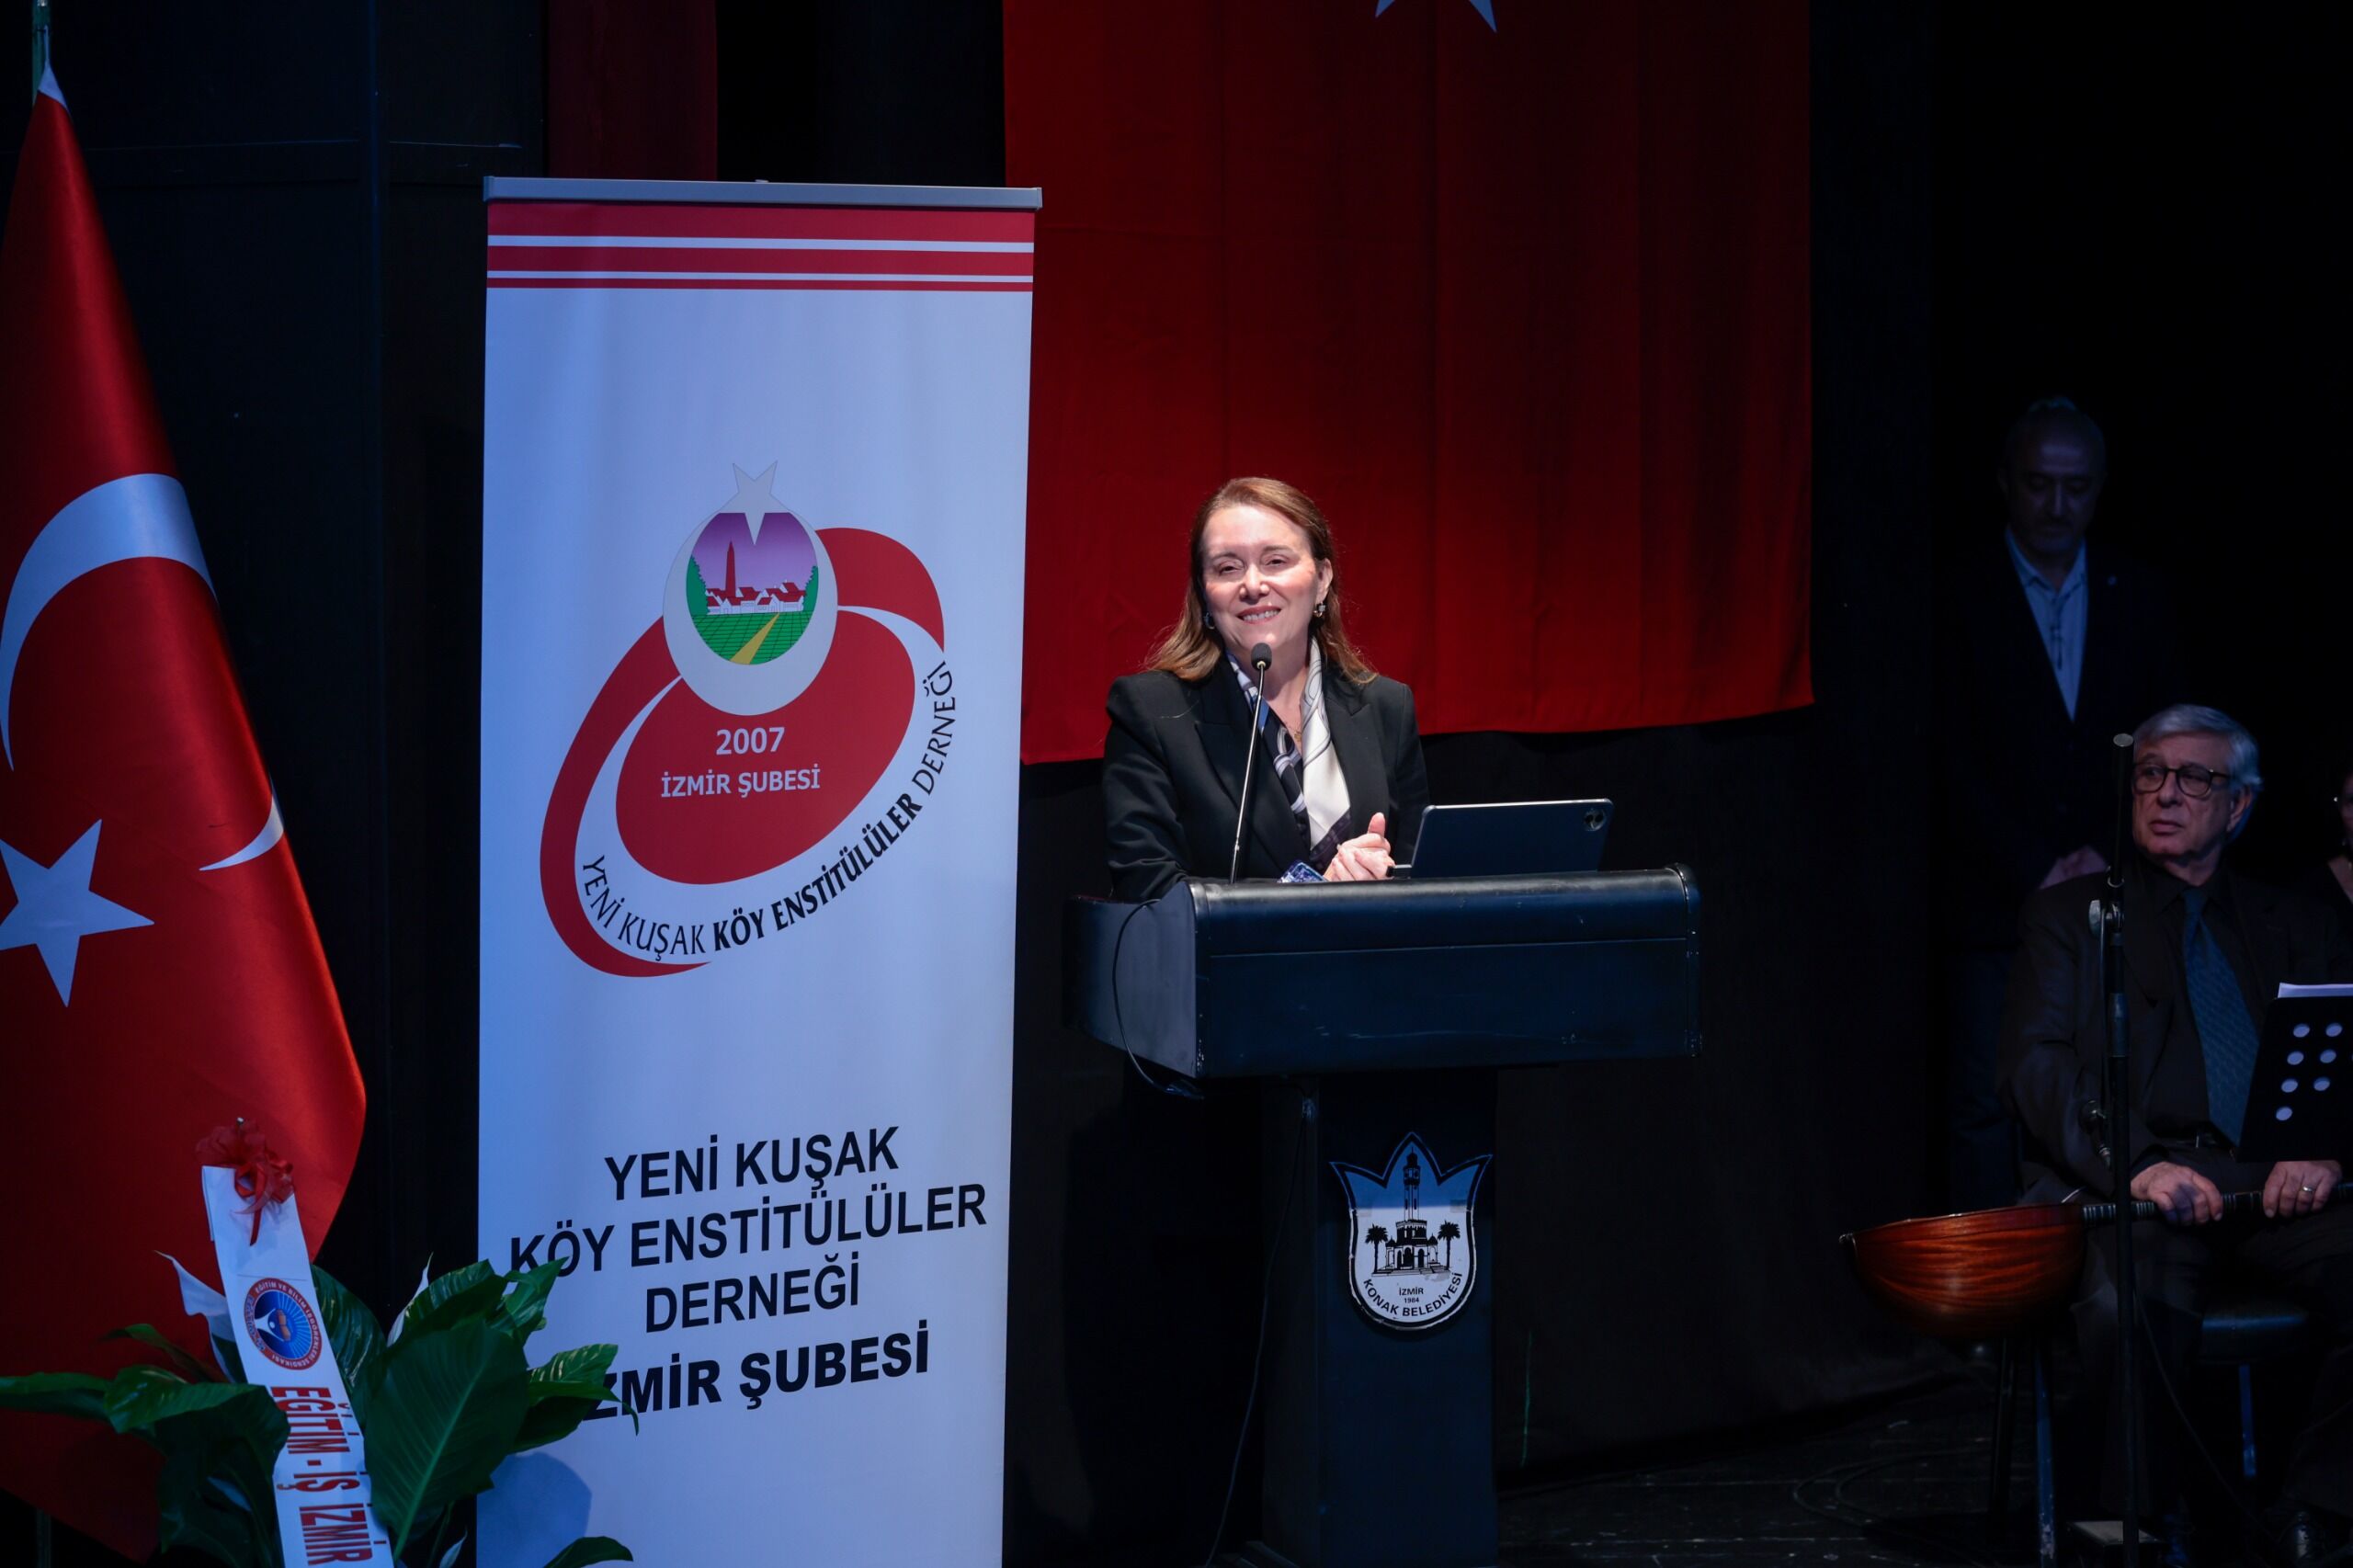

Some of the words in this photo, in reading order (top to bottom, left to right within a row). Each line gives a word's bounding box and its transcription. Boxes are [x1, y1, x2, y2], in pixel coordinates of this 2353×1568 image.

[716, 726, 785, 756] 2007
[582, 855, 625, 929] YENİ
[618, 913, 706, 962] KUŞAK
[713, 906, 766, 952] KÖY
[771, 793, 923, 931] ENSTİTÜLÜLER
[911, 661, 956, 795] DERNEĞİ
[661, 769, 732, 798] İZMİR
[738, 763, 821, 798] ŞUBESİ
[604, 1133, 718, 1201] YENİ
[735, 1126, 899, 1191] KUŞAK
[511, 1219, 615, 1278] KÖY
[631, 1182, 987, 1267] ENSTİTÜLÜLER
[645, 1251, 859, 1334] DERNEĞİ
[1363, 1278, 1399, 1315] KONAK
[1402, 1272, 1462, 1317] BELEDİYESİ
[1399, 1287, 1424, 1296] İZMİR
[583, 1352, 722, 1421] ZMİR
[739, 1319, 928, 1410] ŞUBESİ
[271, 1386, 359, 1454] EĞİTİM
[276, 1471, 369, 1493] İŞ
[299, 1503, 387, 1566] İZMİR
